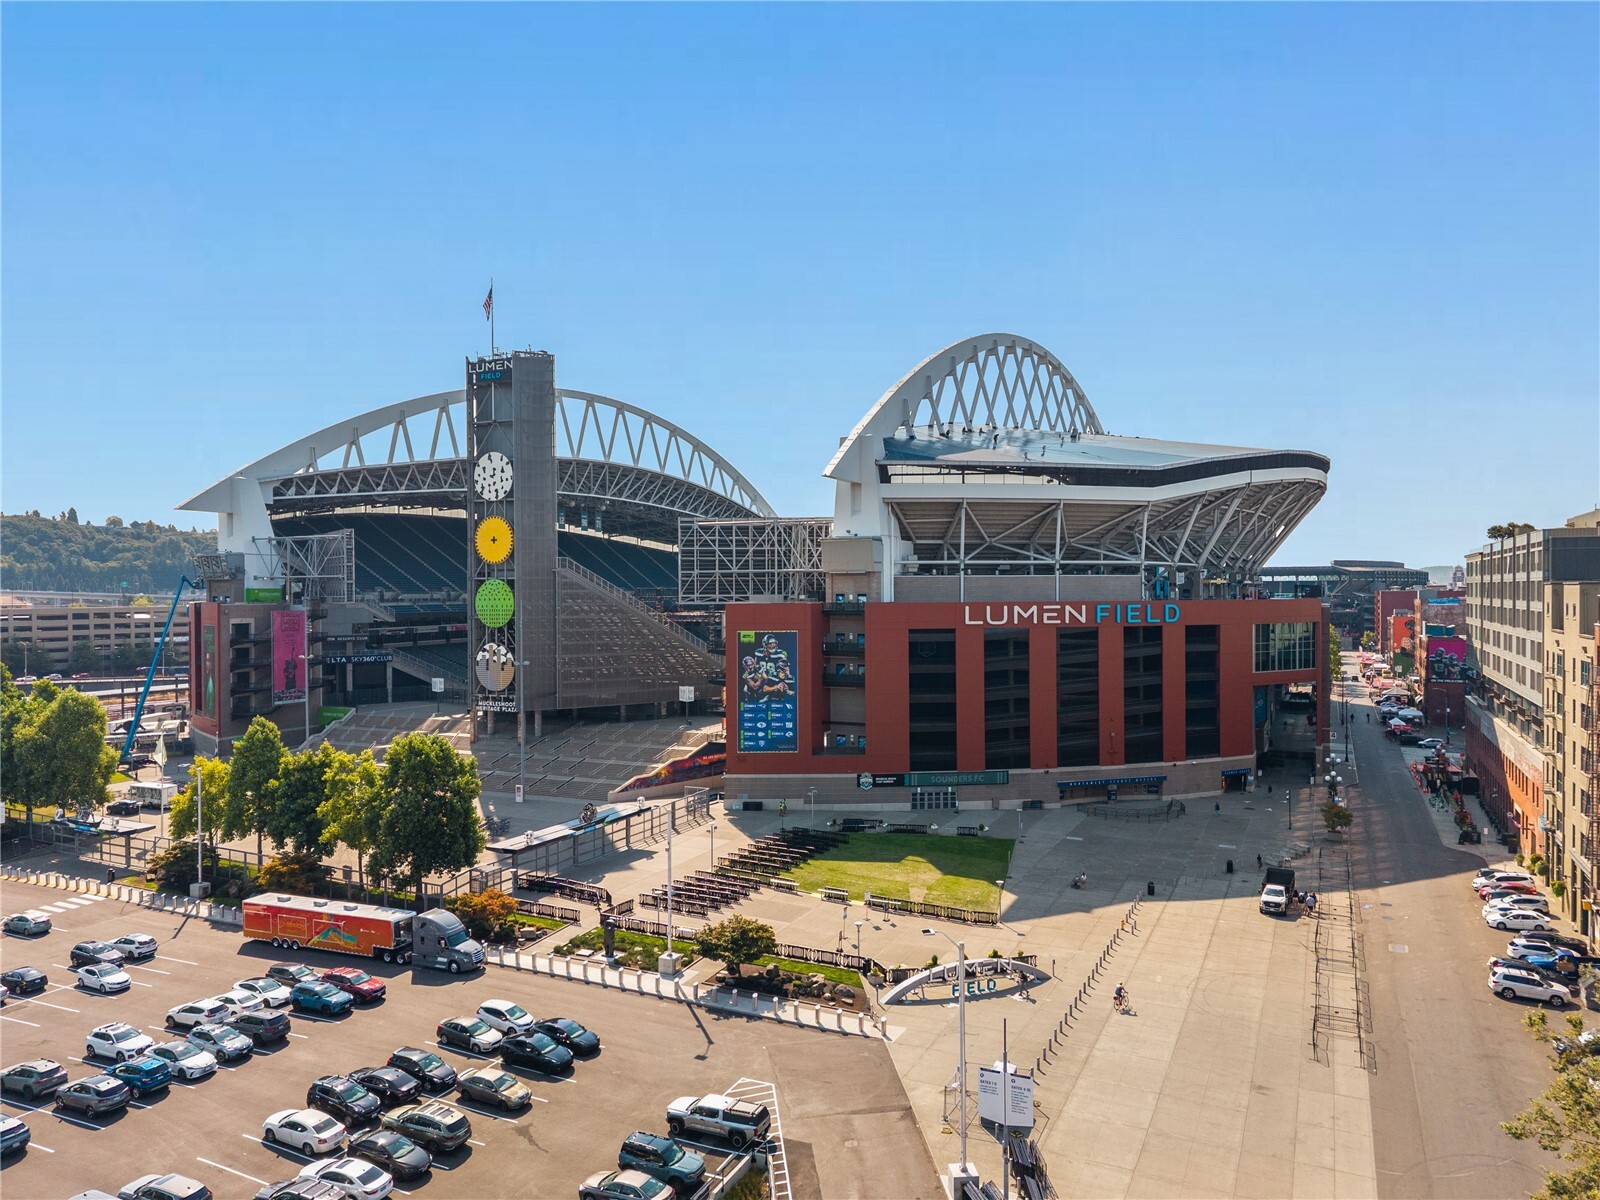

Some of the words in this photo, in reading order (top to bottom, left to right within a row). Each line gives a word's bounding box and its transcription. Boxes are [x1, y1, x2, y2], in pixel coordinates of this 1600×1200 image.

[469, 360, 513, 373] LUMEN
[481, 372, 501, 380] FIELD
[964, 604, 1087, 625] LUMEN
[1095, 603, 1181, 624] FIELD
[931, 775, 970, 783] SOUNDERS
[928, 957, 1012, 983] LUMEN
[952, 978, 997, 997] FELD
